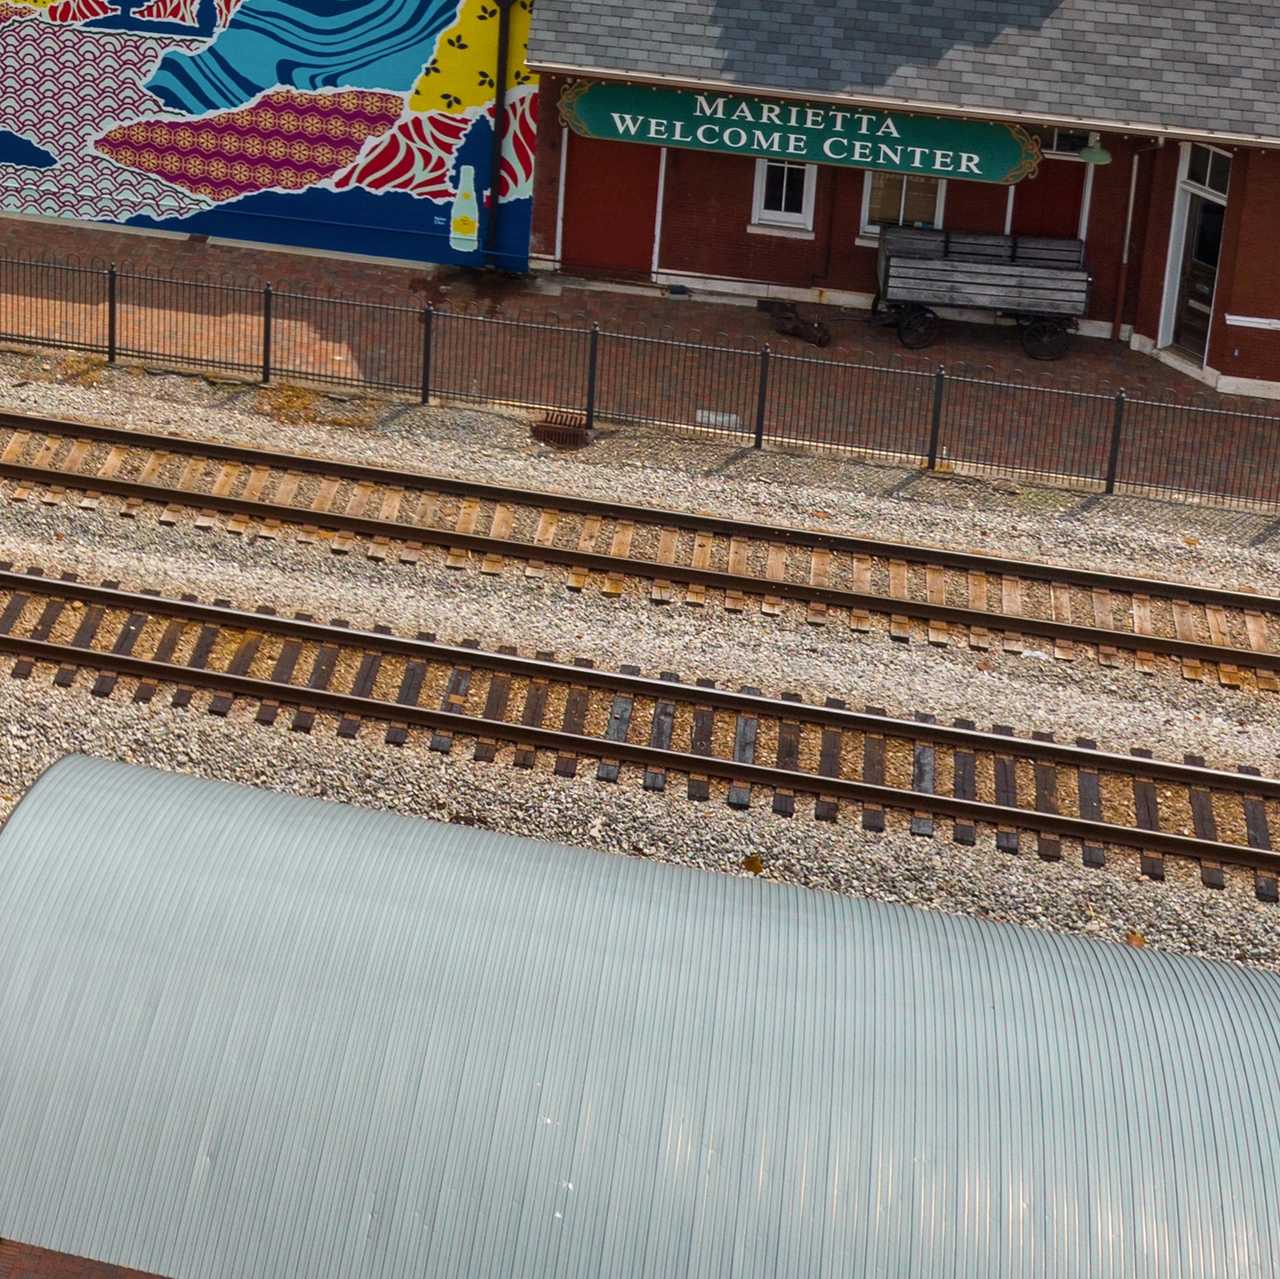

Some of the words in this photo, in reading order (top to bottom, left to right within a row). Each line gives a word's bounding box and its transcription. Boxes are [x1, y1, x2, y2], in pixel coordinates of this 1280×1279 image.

[693, 94, 902, 138] MARIETTA
[611, 112, 808, 155] WELCOME
[822, 137, 983, 174] CENTER
